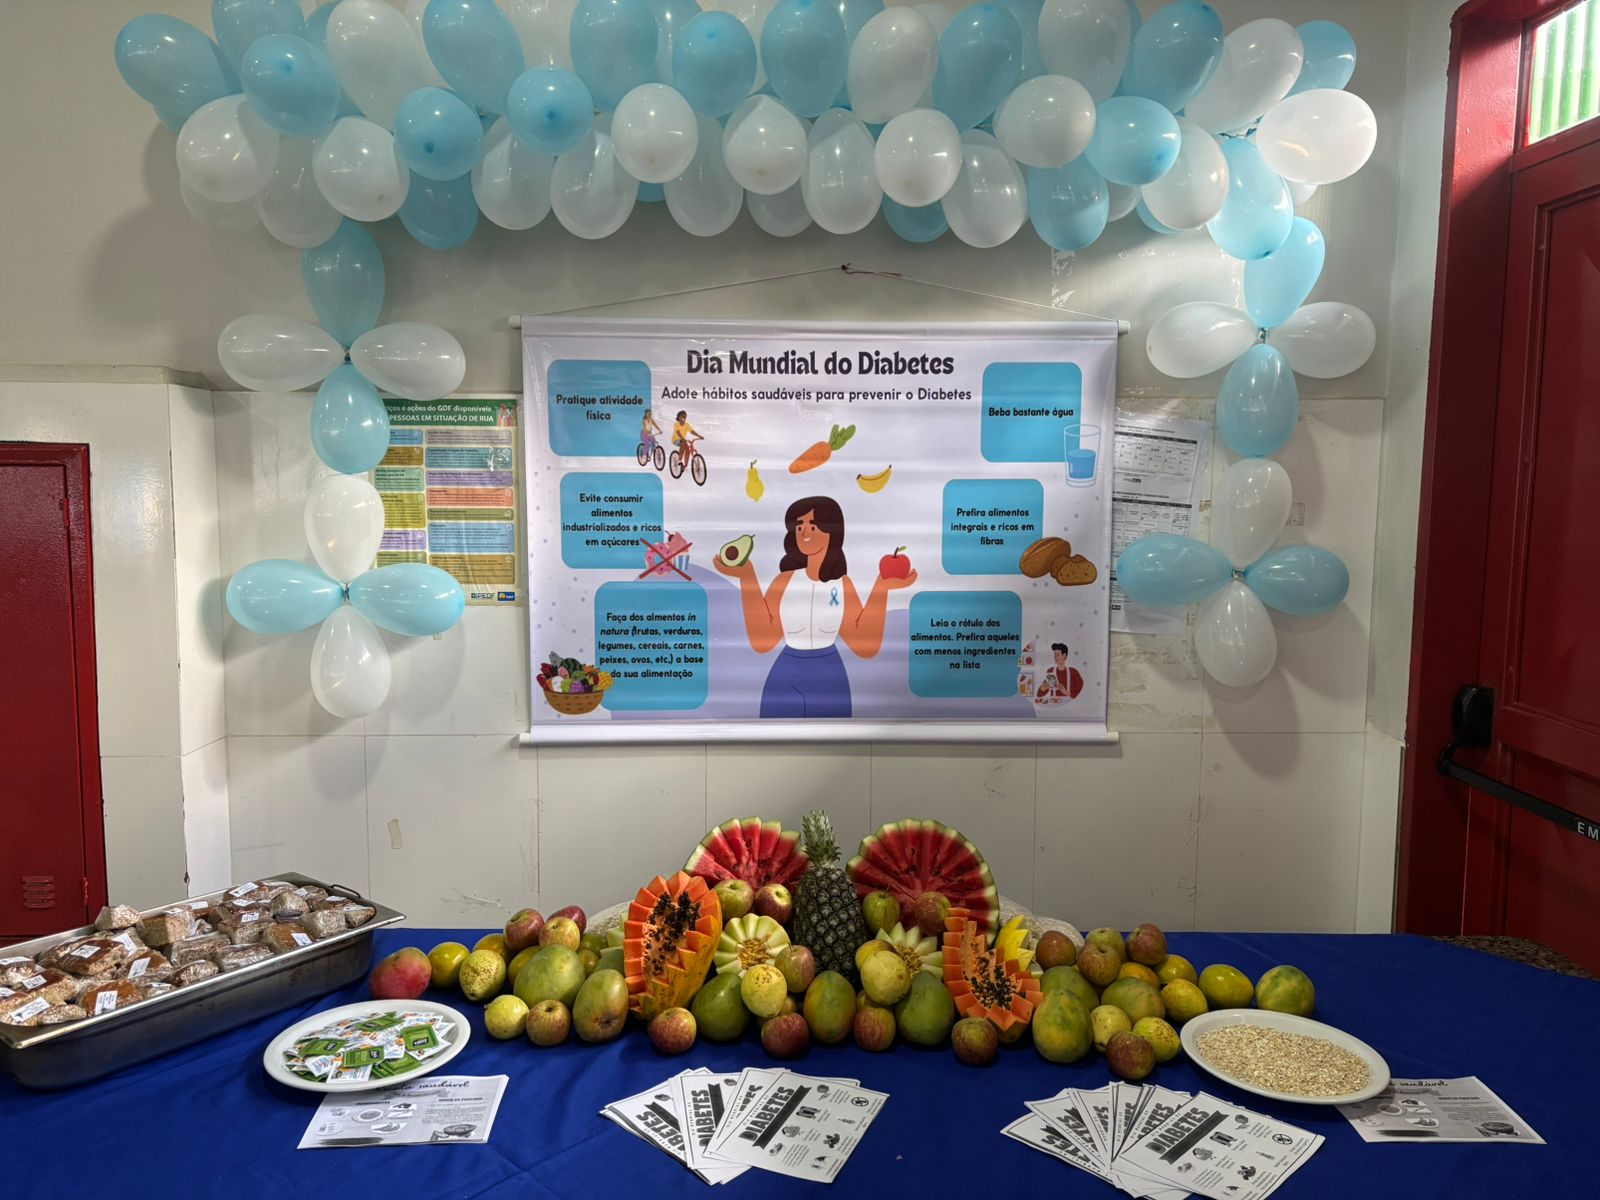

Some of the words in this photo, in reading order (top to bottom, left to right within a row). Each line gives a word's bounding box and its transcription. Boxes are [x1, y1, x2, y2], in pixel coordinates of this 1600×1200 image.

[687, 349, 723, 374] Dia
[729, 350, 819, 375] Mundial
[824, 350, 852, 375] do
[858, 350, 955, 375] Diabetes
[556, 394, 597, 406] Pratique
[599, 395, 643, 405] atividade
[661, 386, 698, 399] Adote
[702, 386, 748, 400] hábitos
[751, 386, 812, 401] saudáveis
[816, 390, 845, 403] para
[849, 388, 902, 403] prevenir
[906, 391, 914, 400] o
[918, 388, 972, 401] Diabetes
[407, 405, 426, 413] ações
[453, 405, 492, 413] disponíveis
[988, 407, 1011, 416] Beba
[1013, 407, 1050, 416] bastante
[1053, 407, 1074, 418] água
[433, 413, 468, 423] SITUAÇÃO
[579, 493, 601, 502] Evite
[604, 493, 644, 503] consumir
[591, 508, 633, 517] alimentos
[956, 508, 986, 517] Prefira
[988, 508, 1030, 517] alimentos
[563, 522, 630, 532] industrializados
[641, 523, 662, 532] ricos
[951, 522, 988, 533] integrais
[998, 523, 1019, 531] ricos
[601, 536, 640, 548] açúcares
[980, 536, 1004, 545] fibras
[606, 612, 627, 623] Faça
[629, 613, 644, 622] dos
[687, 613, 696, 622] in
[930, 618, 949, 628] Leia
[958, 618, 984, 628] rótulo
[985, 618, 1000, 628] dos
[600, 627, 629, 635] natura
[663, 626, 703, 636] verduras,
[911, 632, 954, 641] alimentos.
[956, 632, 985, 641] Prefira
[987, 632, 1020, 643] aqueles
[598, 641, 636, 652] legumes,
[638, 641, 672, 650] cereais,
[673, 642, 705, 651] carnes,
[963, 646, 1016, 657] ingredientes
[599, 655, 629, 665] peixes,
[631, 656, 653, 665] ovos,
[684, 654, 704, 663] base
[962, 660, 981, 669] lista
[610, 669, 621, 678] da
[641, 669, 693, 680] alimentação
[738, 1086, 795, 1142] DIABETES
[1145, 1107, 1210, 1154] DIABETES
